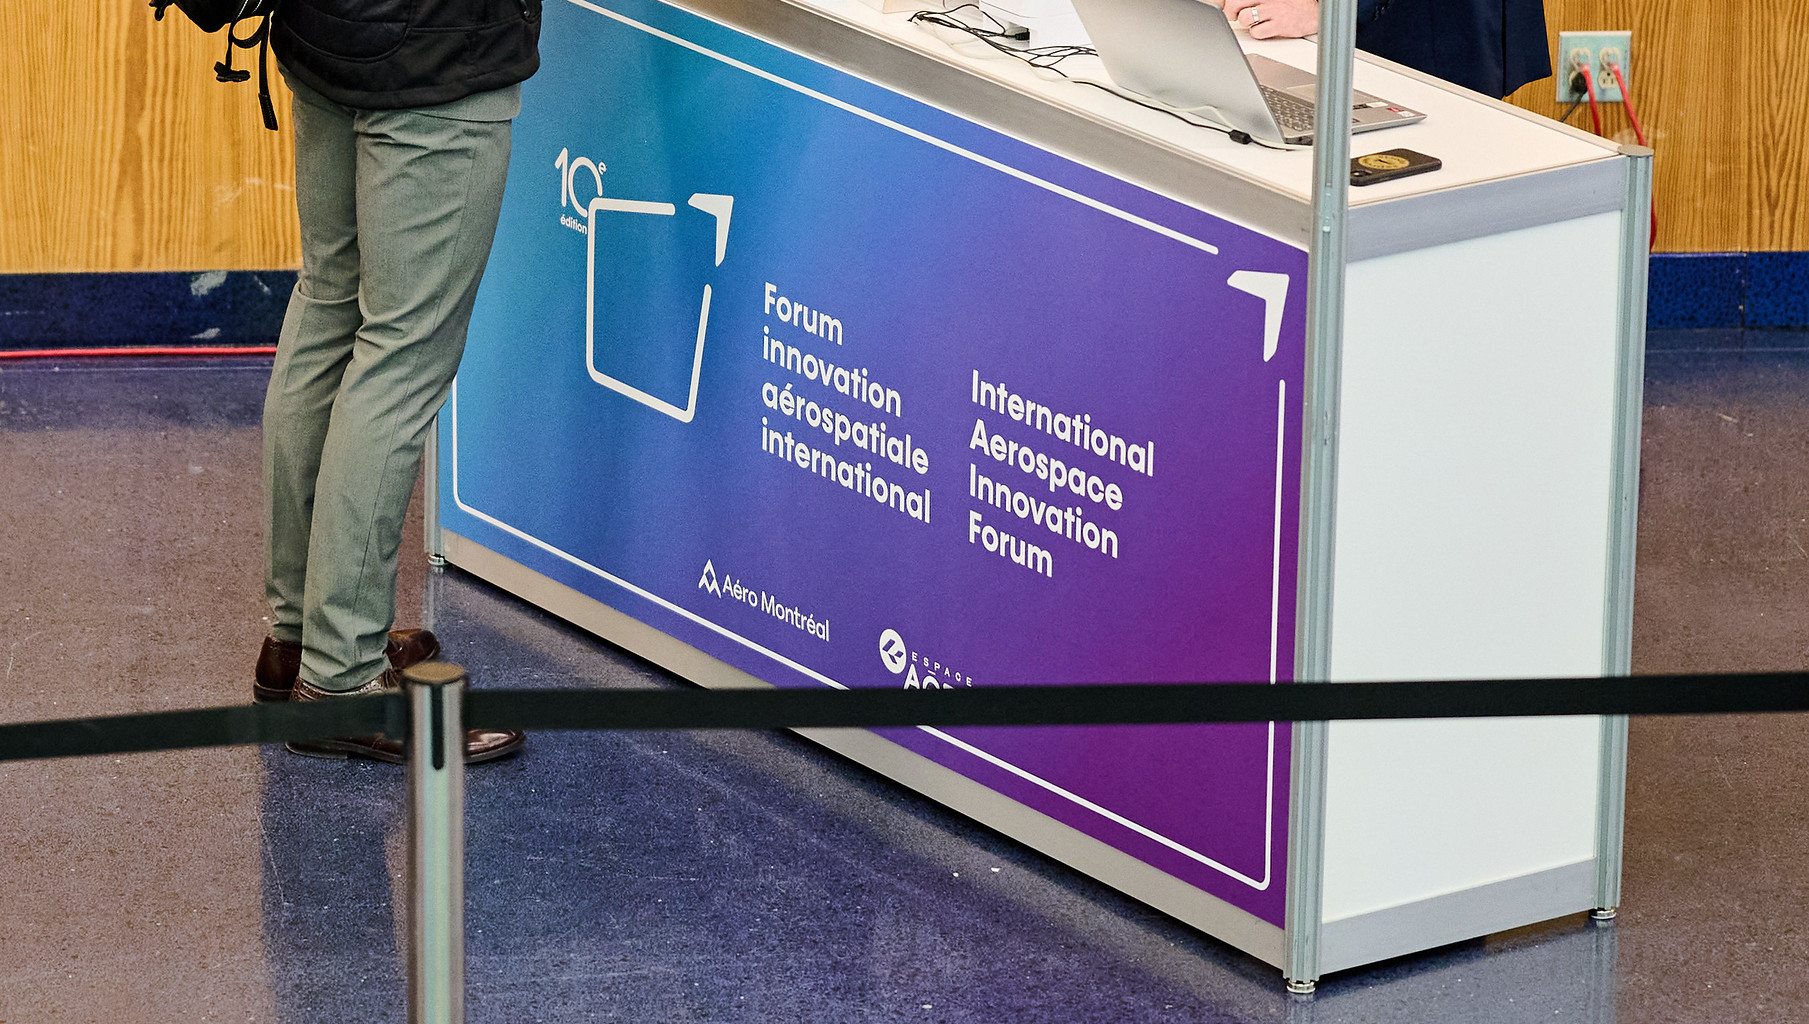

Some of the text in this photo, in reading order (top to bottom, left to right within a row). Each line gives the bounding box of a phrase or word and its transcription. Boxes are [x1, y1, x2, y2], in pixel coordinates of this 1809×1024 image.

[560, 214, 588, 235] édition
[764, 281, 843, 346] Forum
[763, 325, 902, 418] innovation
[762, 381, 929, 475] aérospatiale
[969, 418, 1123, 511] Aerospace
[972, 369, 1154, 477] International
[761, 416, 931, 524] international
[969, 463, 1118, 559] Innovation
[969, 510, 1053, 578] Forum
[722, 574, 830, 642] Aéro Montréal
[911, 651, 973, 688] ESPACE
